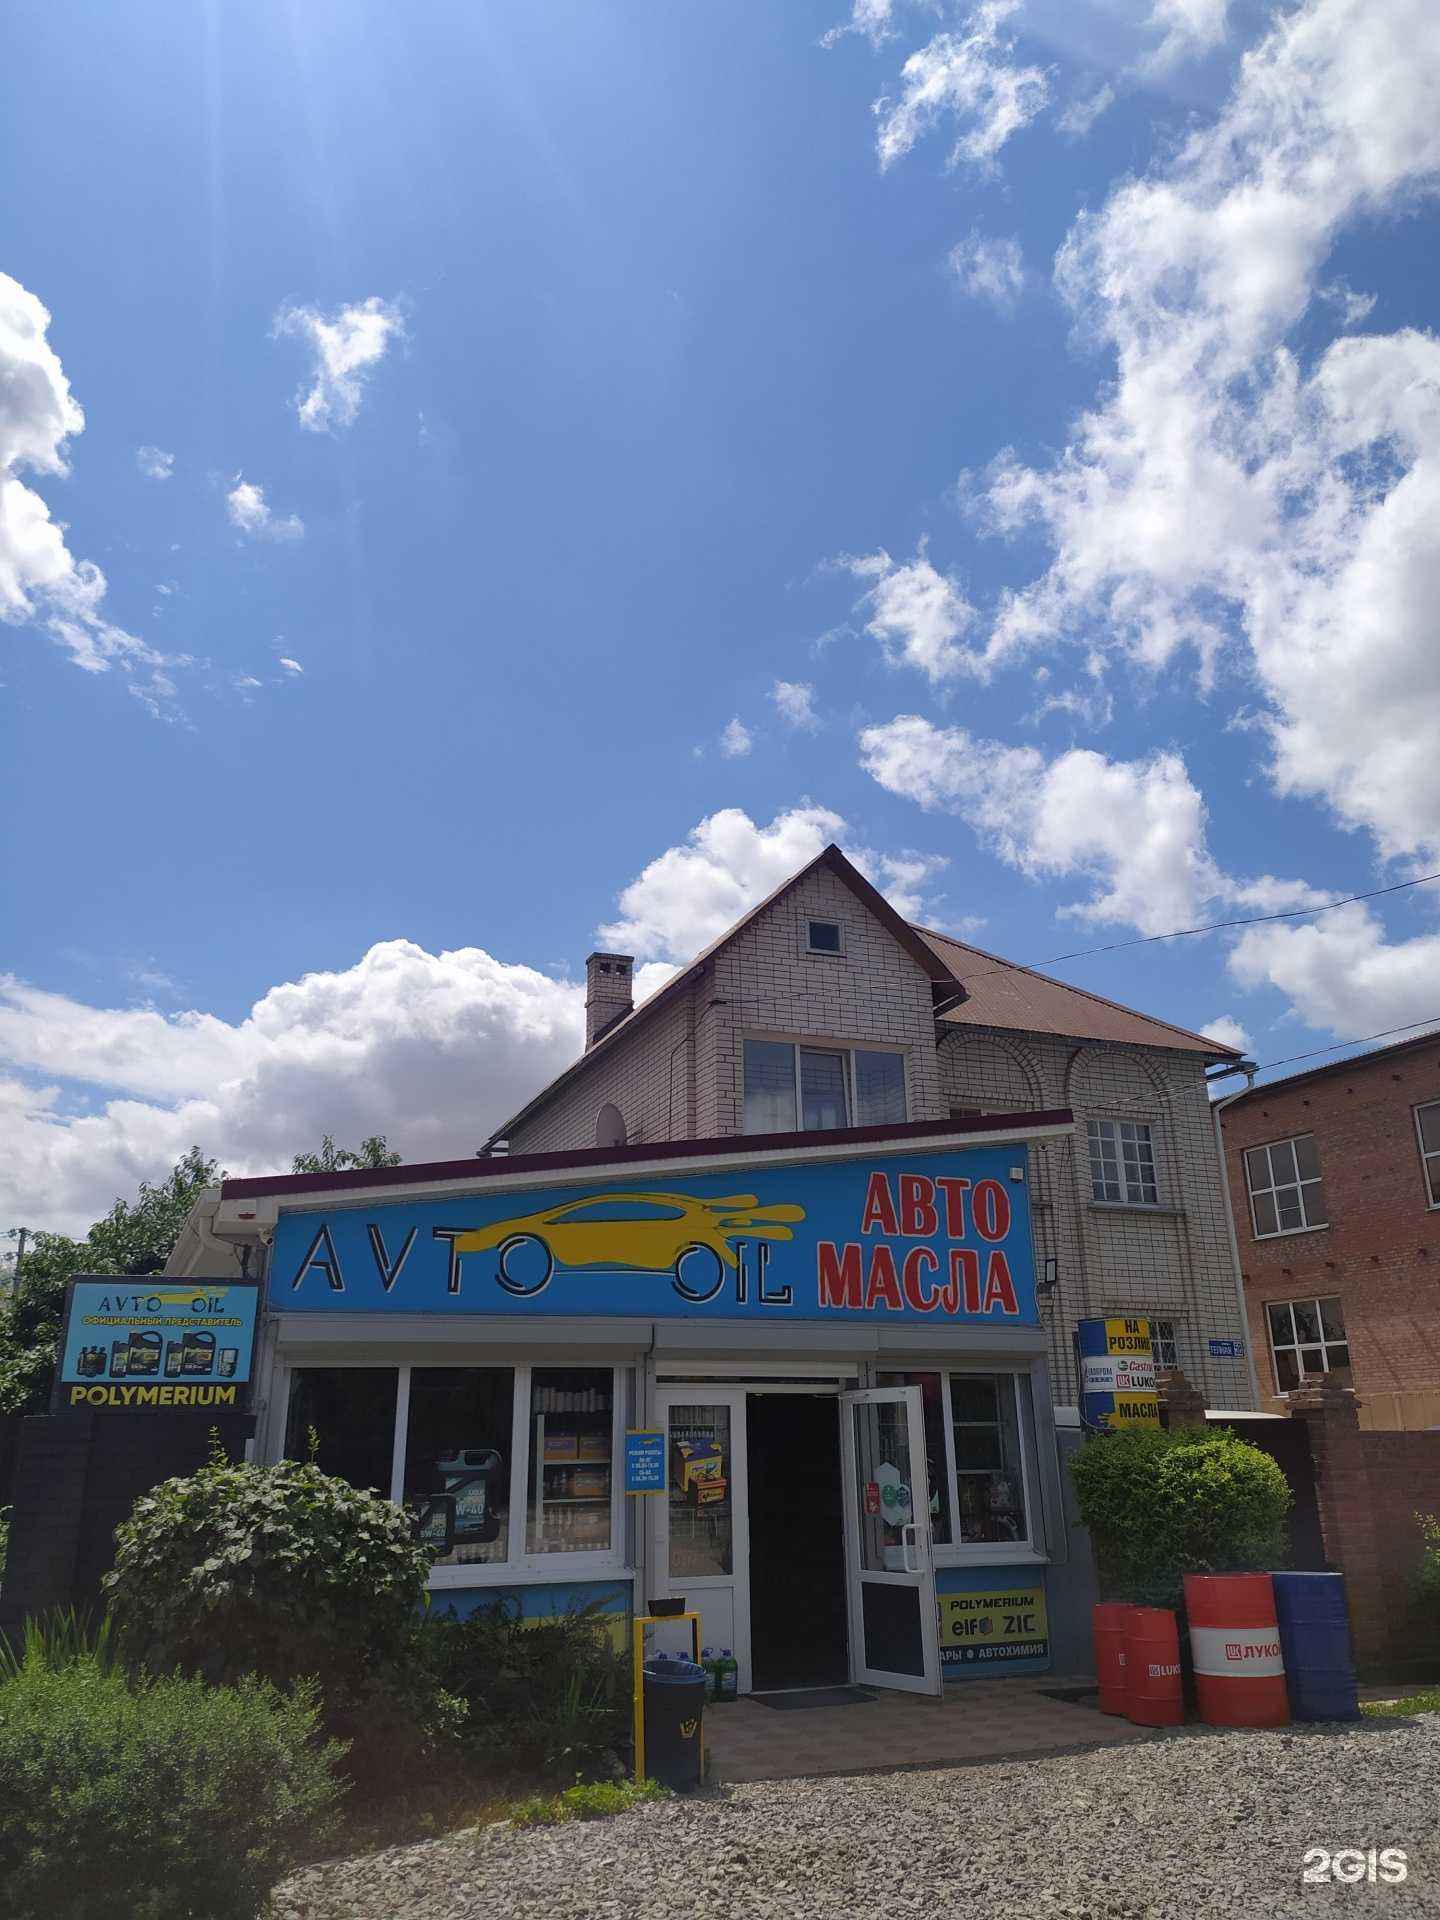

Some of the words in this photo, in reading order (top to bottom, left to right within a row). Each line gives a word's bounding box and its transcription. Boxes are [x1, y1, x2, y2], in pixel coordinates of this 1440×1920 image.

[861, 1171, 1011, 1243] АВТО
[292, 1223, 555, 1299] AVTO
[674, 1240, 793, 1306] OIL
[816, 1242, 1019, 1316] МАСЛА
[98, 1296, 162, 1312] AVTO
[192, 1297, 225, 1313] OIL
[83, 1316, 163, 1326] ОФИЦИАЛЬНЫЙ
[165, 1317, 242, 1327] ПРЕДСТАВИТЕЛЬ
[1125, 1319, 1140, 1334] НА
[70, 1384, 236, 1406] POLYMERIUM
[950, 1596, 1034, 1611] POLYMERIUM
[952, 1618, 978, 1636] elf
[1004, 1614, 1036, 1633] ZIC
[940, 1649, 962, 1662] АРЫ
[979, 1643, 1044, 1659] АВТОХИМИЯ
[1243, 1641, 1281, 1659] ЛУКО
